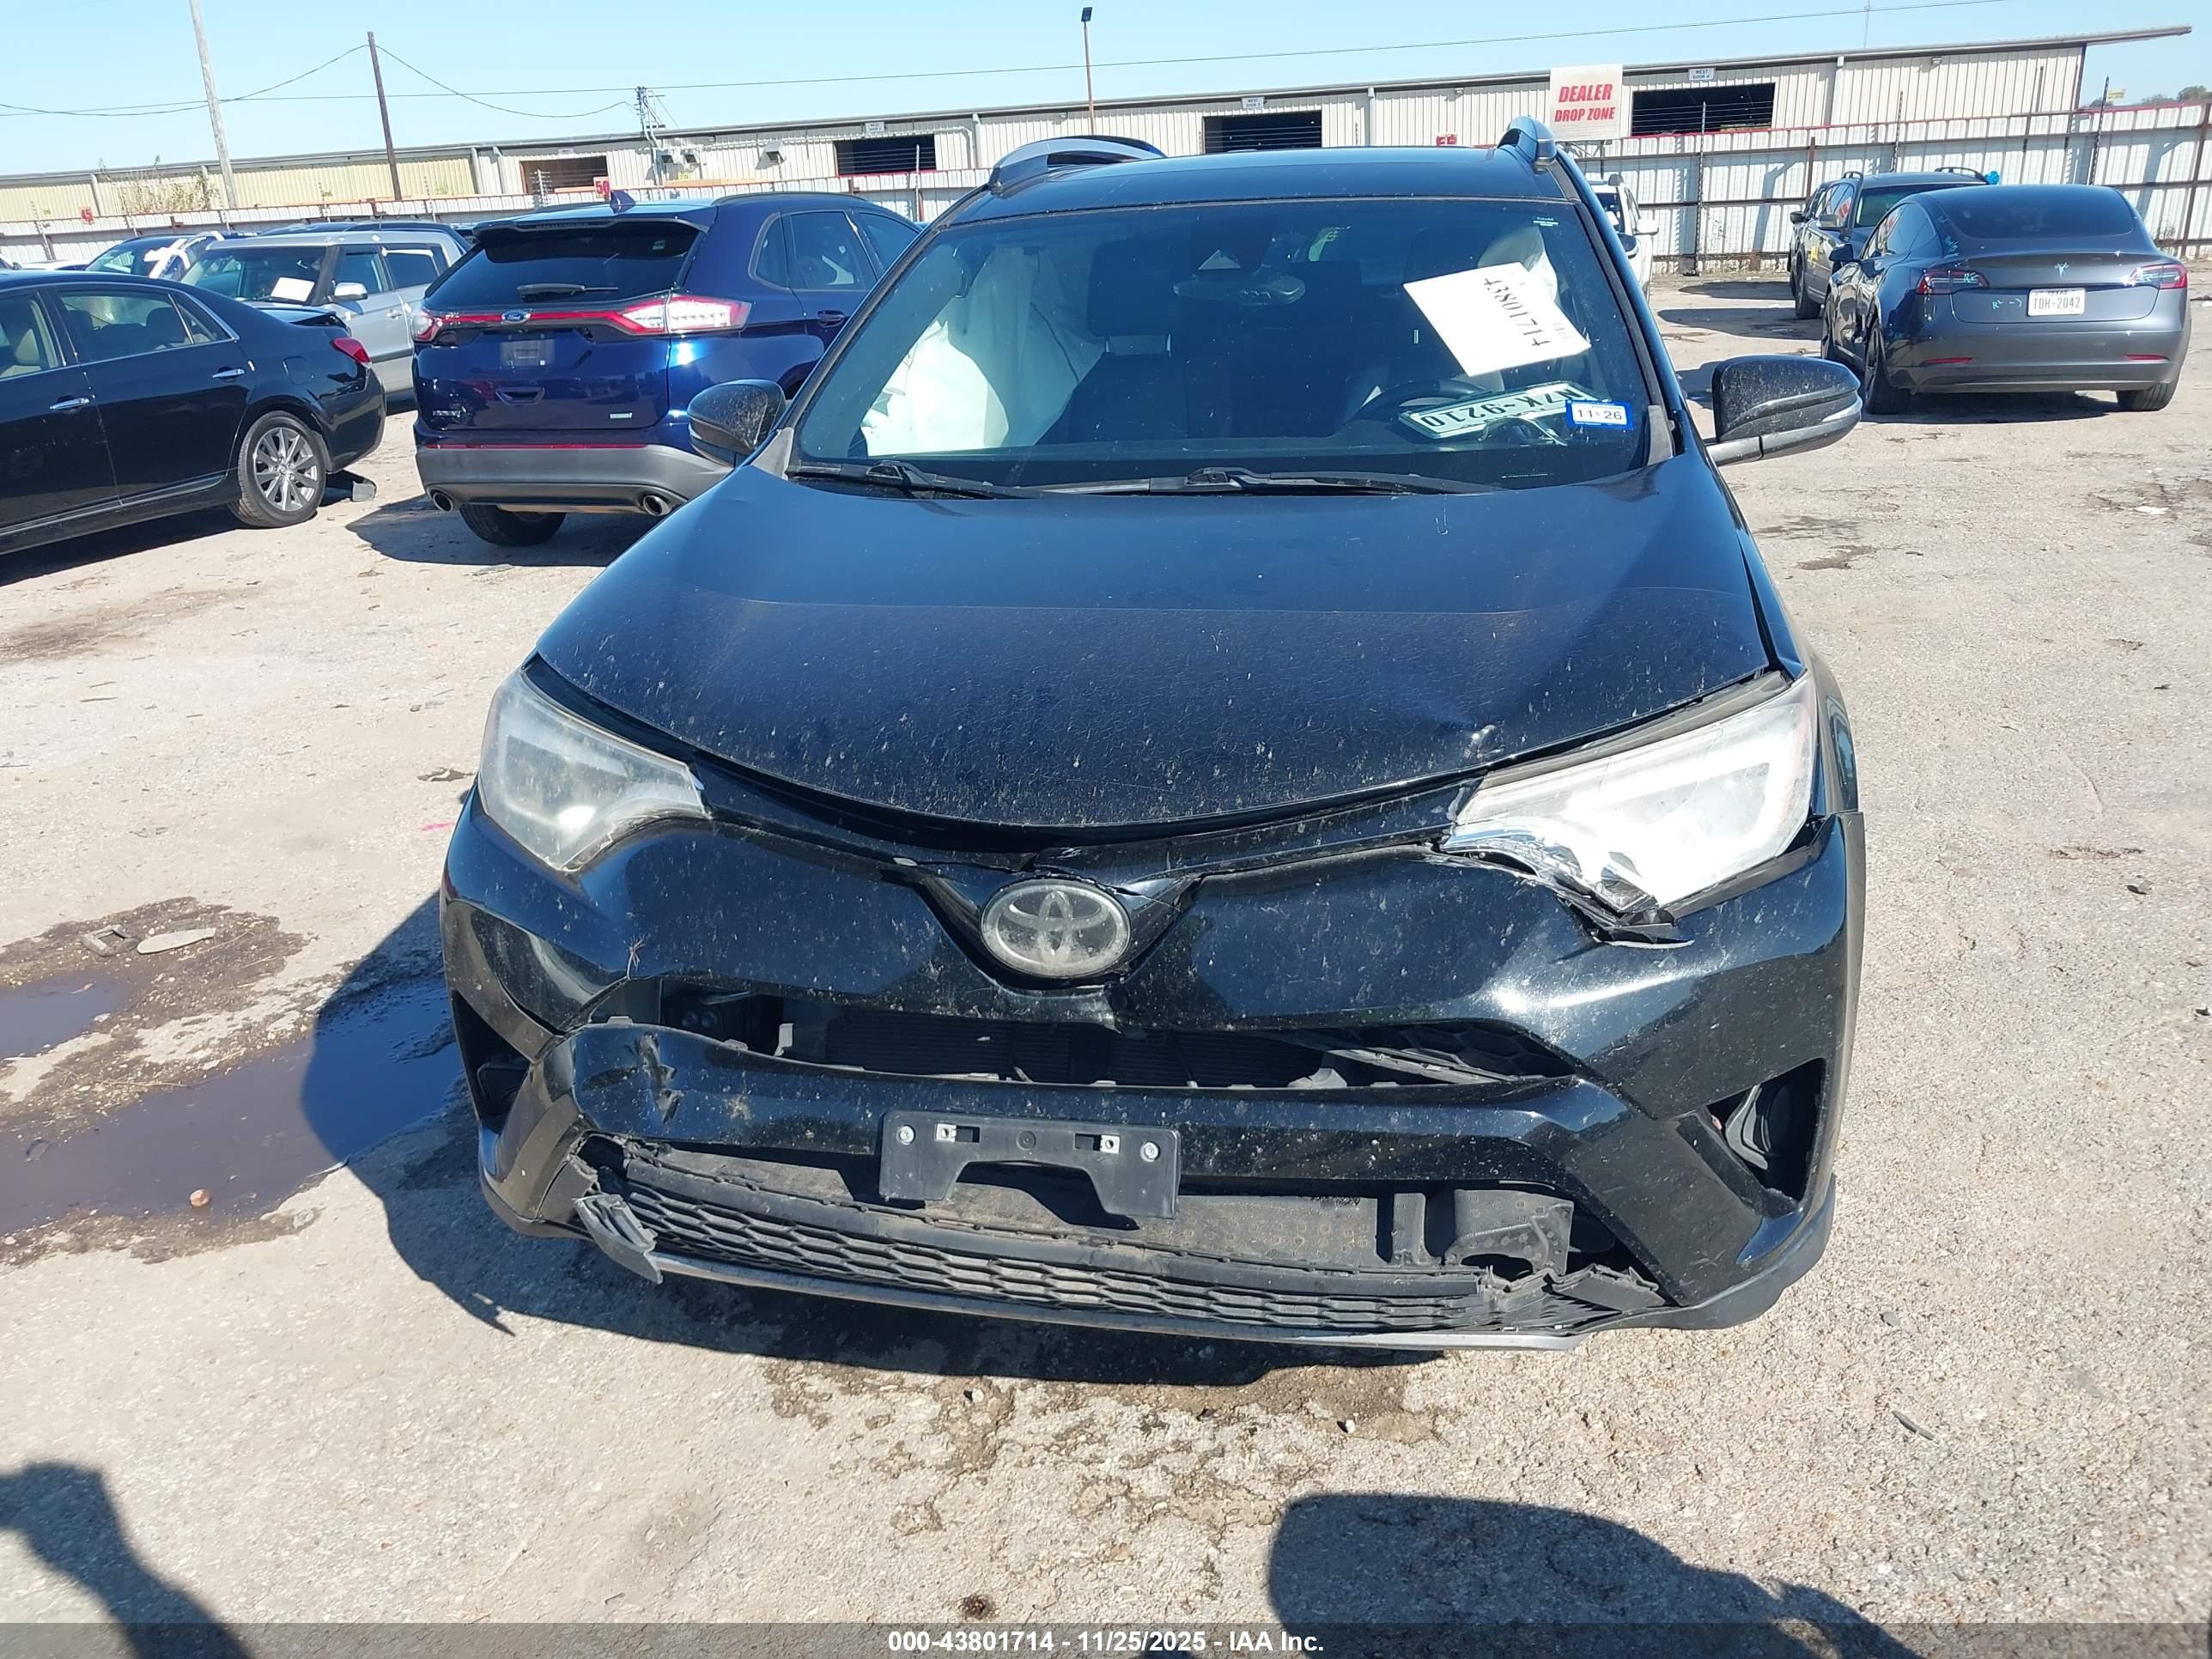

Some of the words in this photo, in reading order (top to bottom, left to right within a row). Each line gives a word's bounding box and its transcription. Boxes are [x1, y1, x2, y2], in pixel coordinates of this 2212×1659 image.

[1558, 83, 1613, 103] DEALER
[1554, 108, 1585, 122] DROP
[1586, 106, 1616, 120] ZONE
[1483, 277, 1553, 347] 43801714
